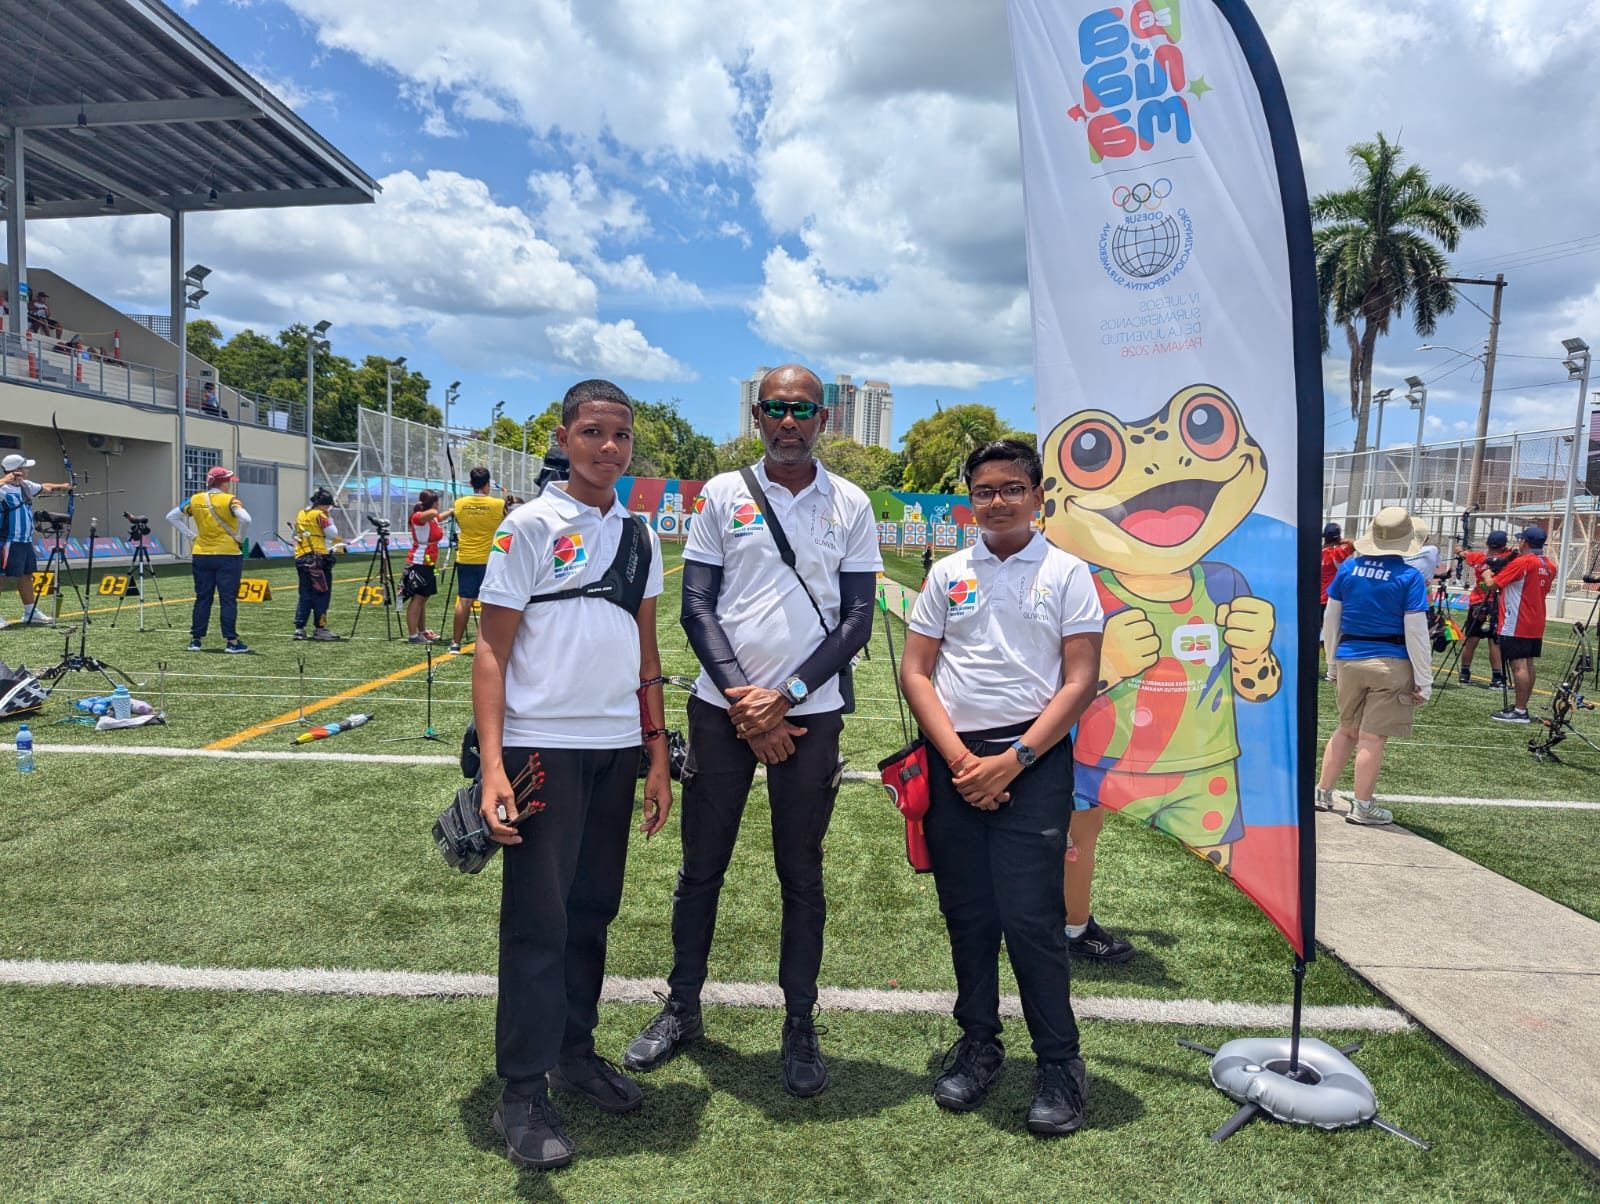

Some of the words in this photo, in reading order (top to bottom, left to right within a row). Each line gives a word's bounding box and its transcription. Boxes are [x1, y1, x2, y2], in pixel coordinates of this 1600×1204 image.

[1352, 566, 1392, 581] JUDGE
[99, 575, 129, 595] 03
[356, 585, 385, 606] 05
